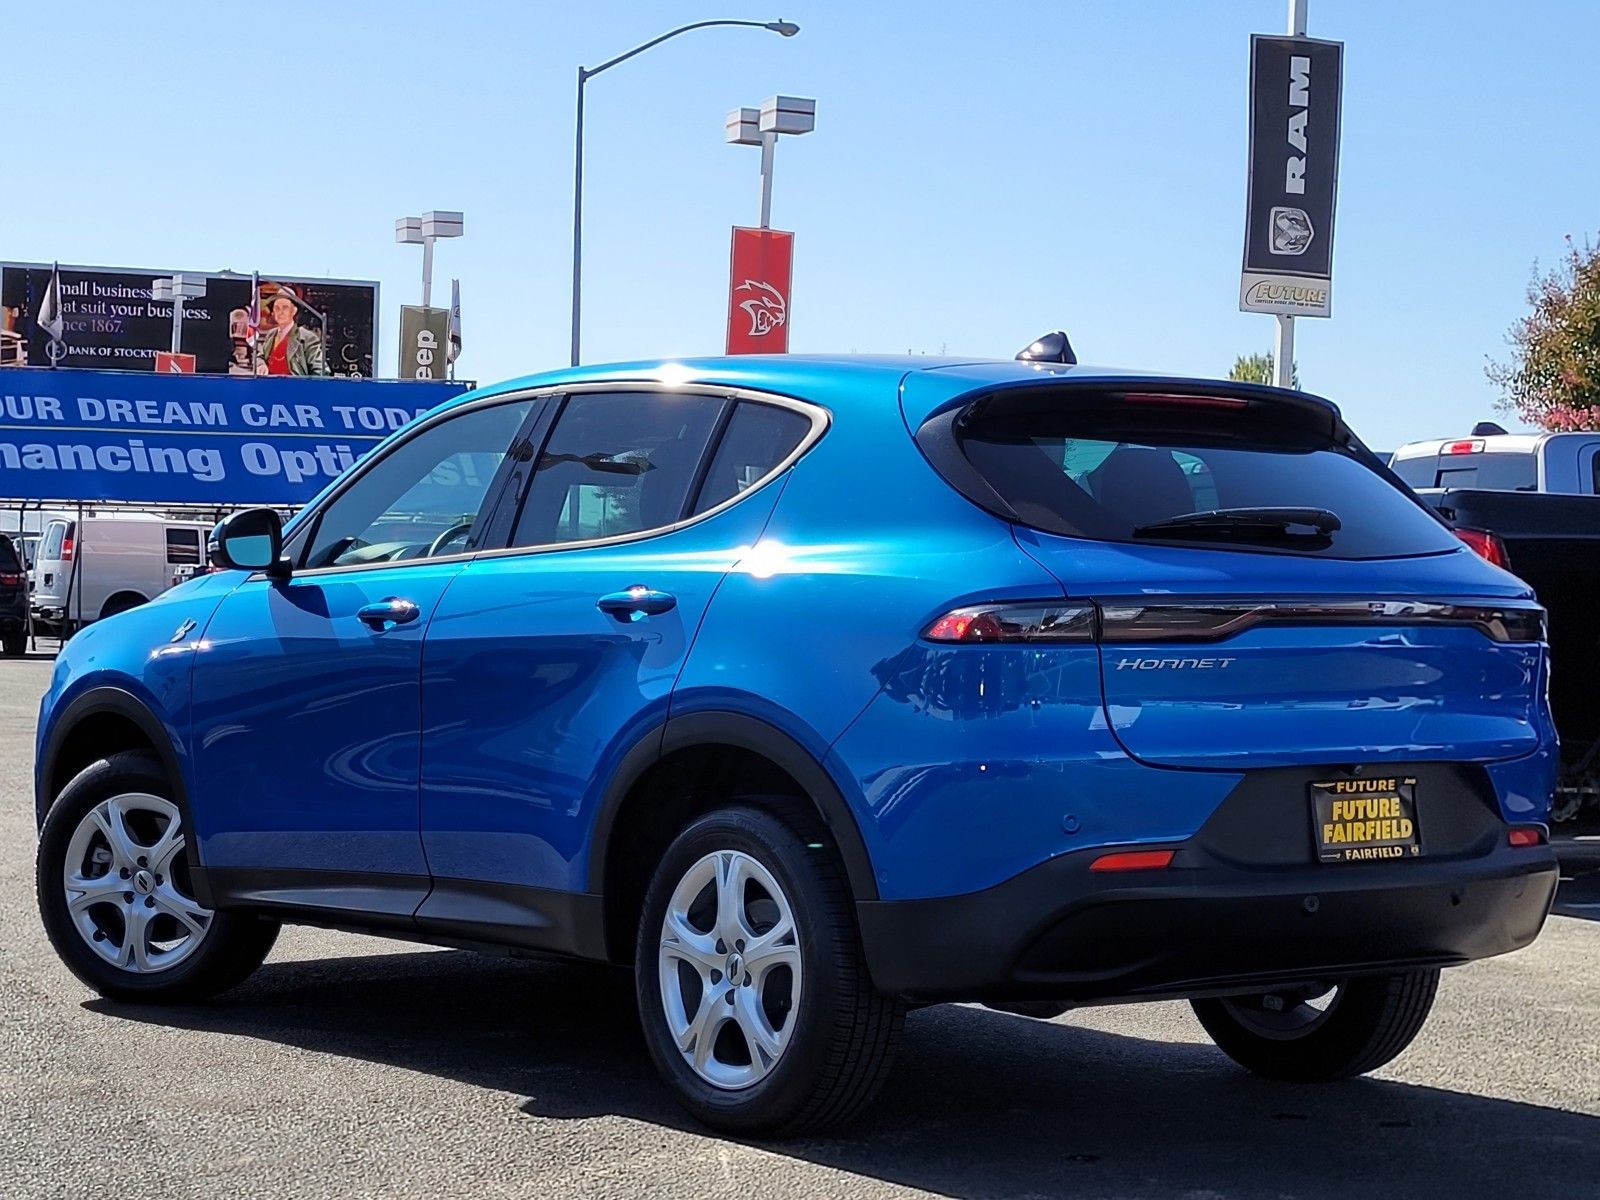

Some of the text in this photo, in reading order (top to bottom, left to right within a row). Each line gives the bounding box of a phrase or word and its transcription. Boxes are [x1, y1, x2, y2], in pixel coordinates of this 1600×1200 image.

[1285, 56, 1311, 194] RAM
[60, 281, 153, 298] mall business
[1256, 285, 1326, 303] FUTURE
[62, 300, 76, 313] at
[81, 300, 106, 315] suit
[110, 304, 143, 318] your
[62, 319, 124, 333] nce 1867.
[69, 346, 97, 356] BANK
[98, 347, 112, 356] OF
[415, 330, 438, 379] eep
[0, 395, 64, 420] UR
[77, 398, 228, 426] DREAM
[241, 403, 324, 428] CAR
[1116, 658, 1236, 670] HORNET
[1336, 779, 1396, 793] FUTURE
[1332, 797, 1400, 821] FUTURE
[1323, 819, 1413, 844] FAIRFIELD
[1345, 846, 1403, 860] FAIRFIELD
